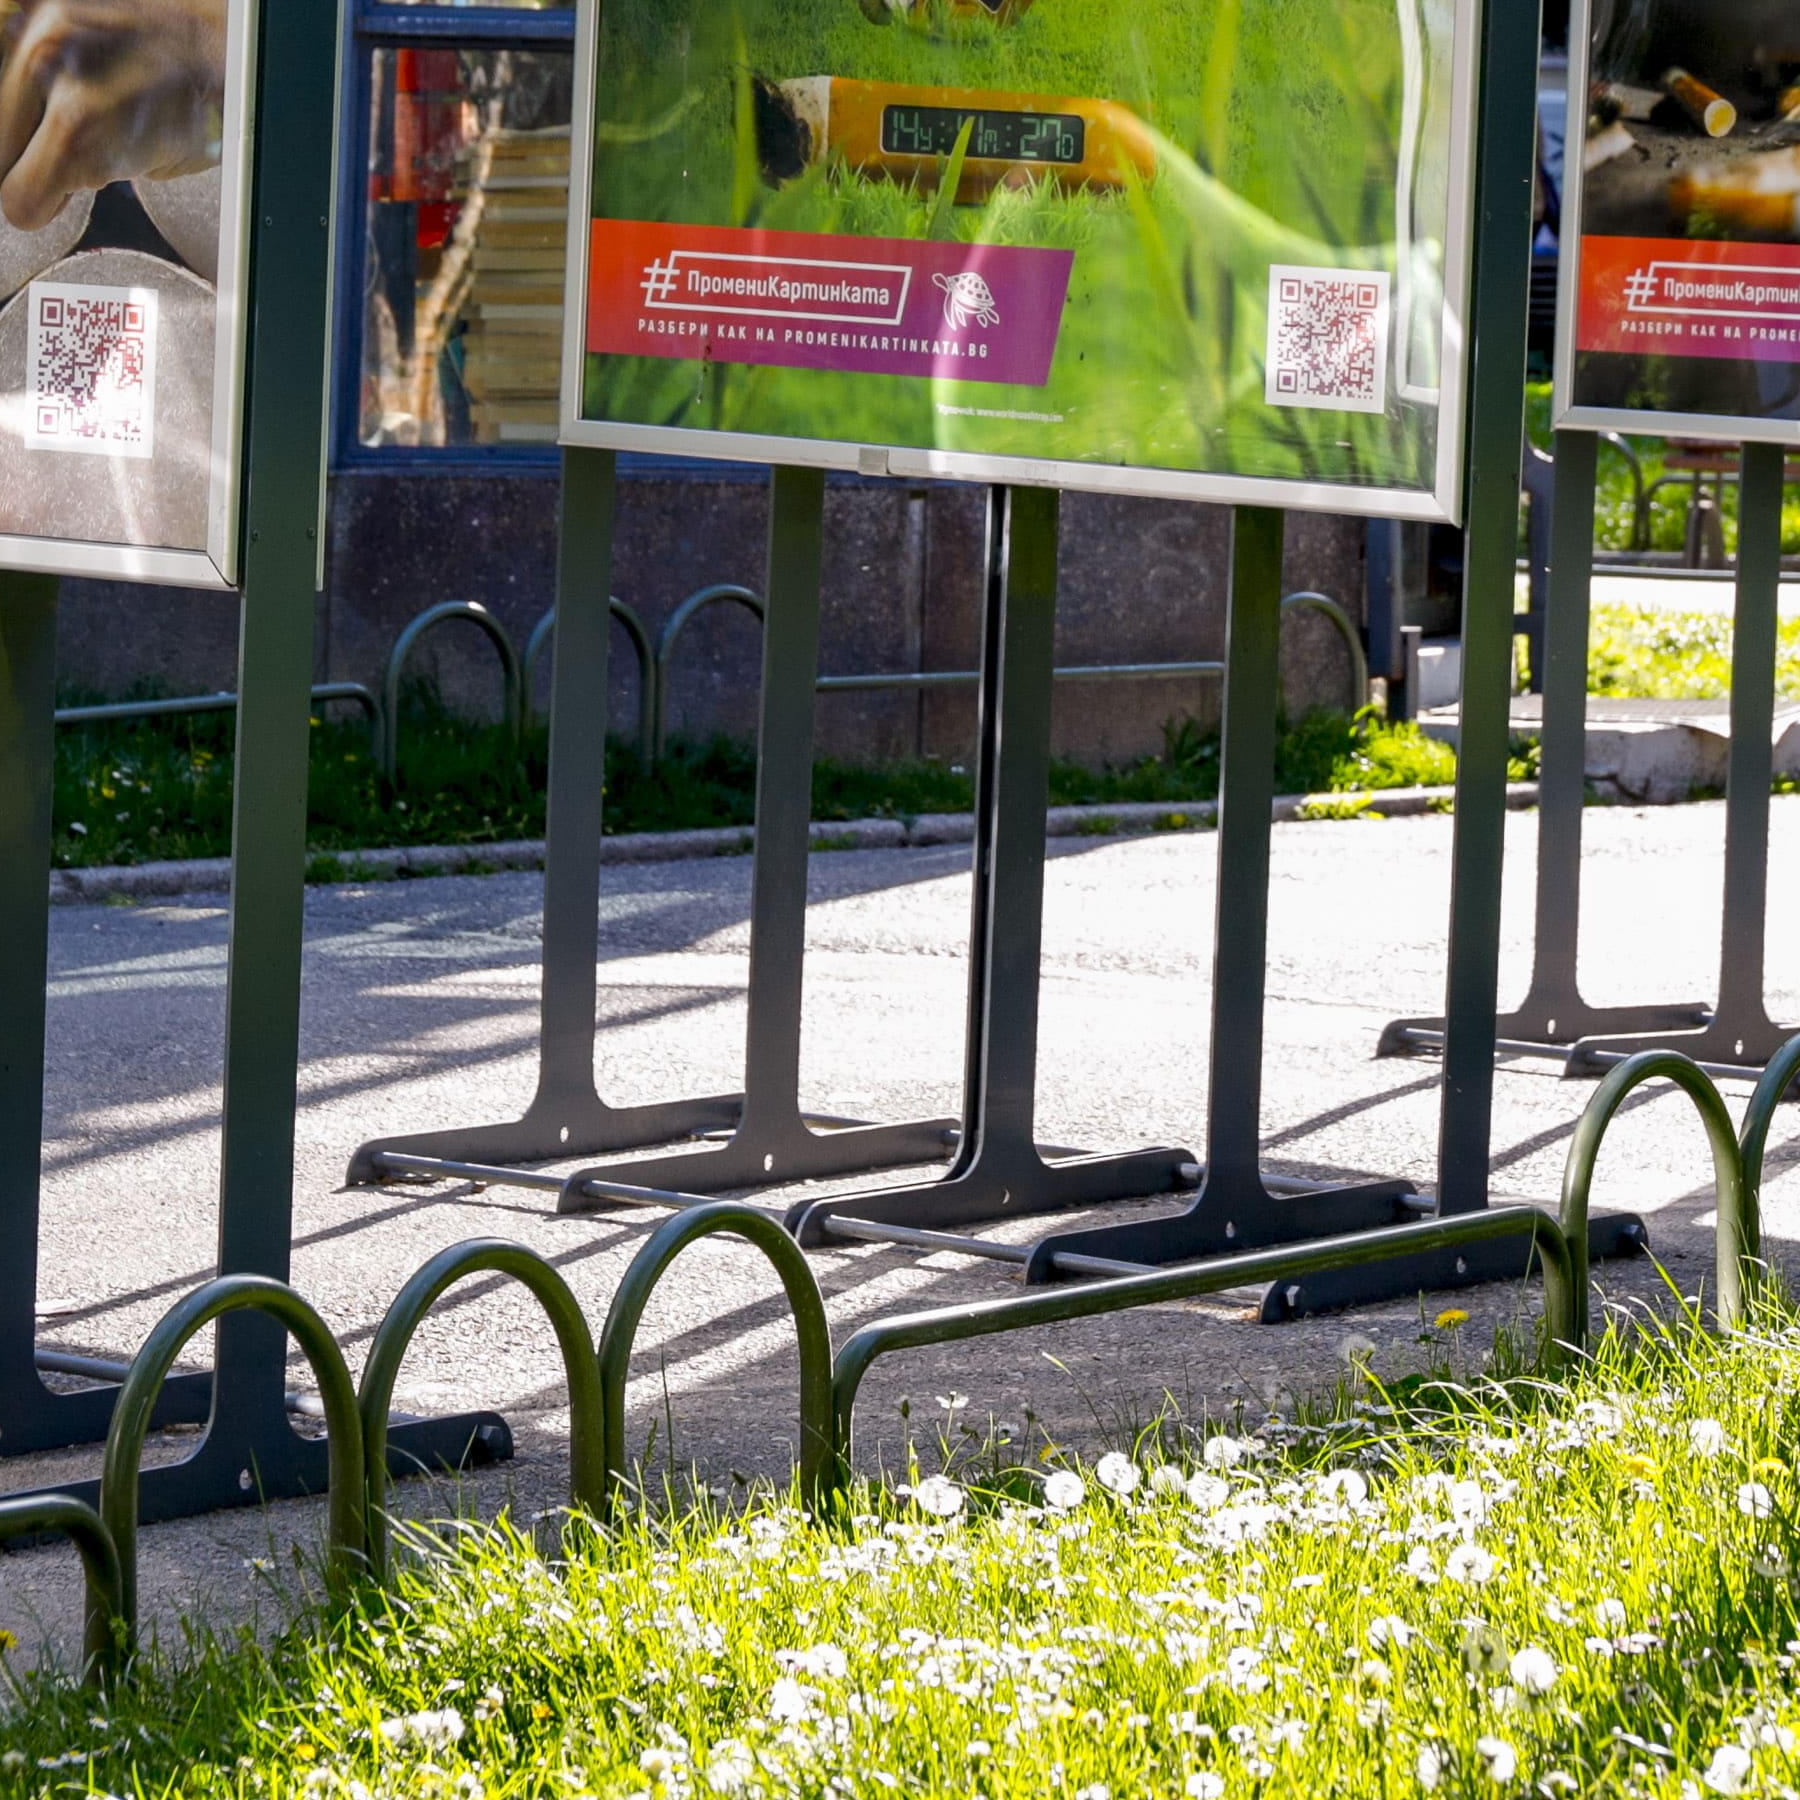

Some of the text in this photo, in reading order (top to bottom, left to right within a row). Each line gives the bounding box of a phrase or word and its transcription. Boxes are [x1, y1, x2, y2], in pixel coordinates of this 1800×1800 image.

[638, 317, 988, 358] РАЗБЕРИ КАК НА PROMENIKARTINKATA.BG
[1621, 319, 1683, 335] РАЗБЕРИ
[1691, 323, 1716, 338] КАК
[1724, 325, 1741, 339] НА
